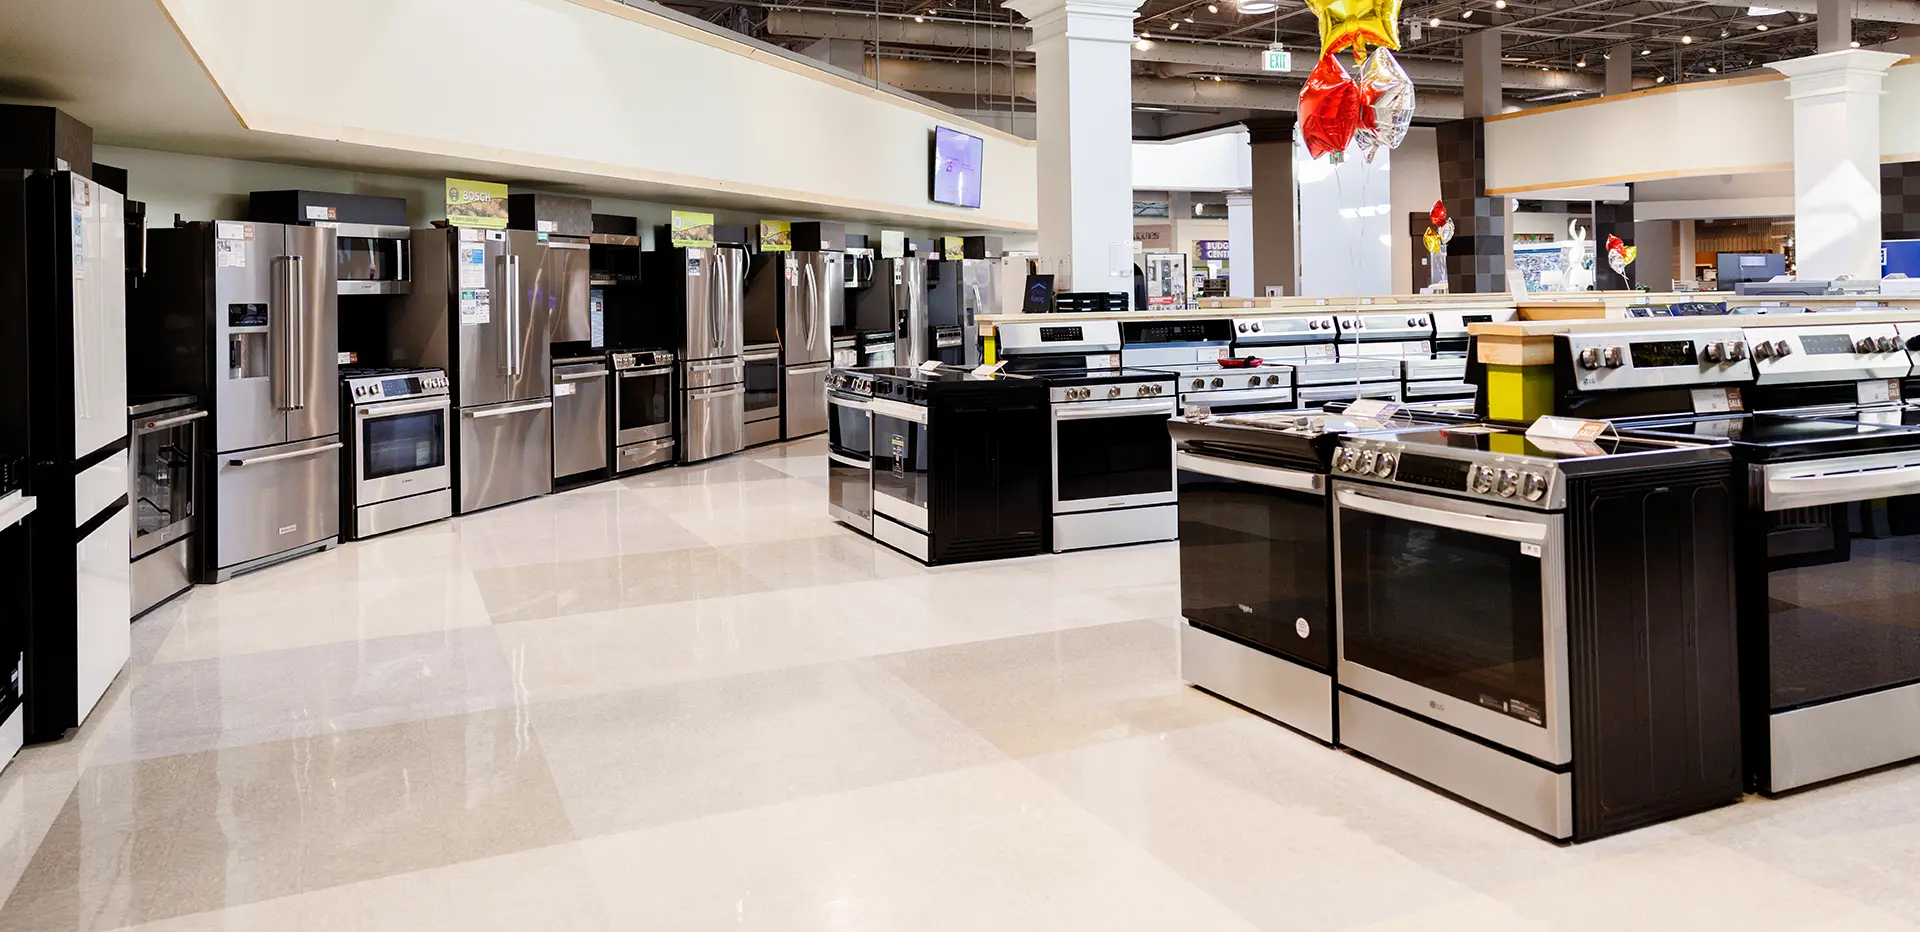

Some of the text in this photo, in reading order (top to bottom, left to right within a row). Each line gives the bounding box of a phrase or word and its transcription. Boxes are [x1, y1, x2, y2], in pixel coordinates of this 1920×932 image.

[1270, 54, 1286, 68] EXIT
[463, 190, 491, 202] BOSCH
[1729, 399, 1742, 408] SALE
